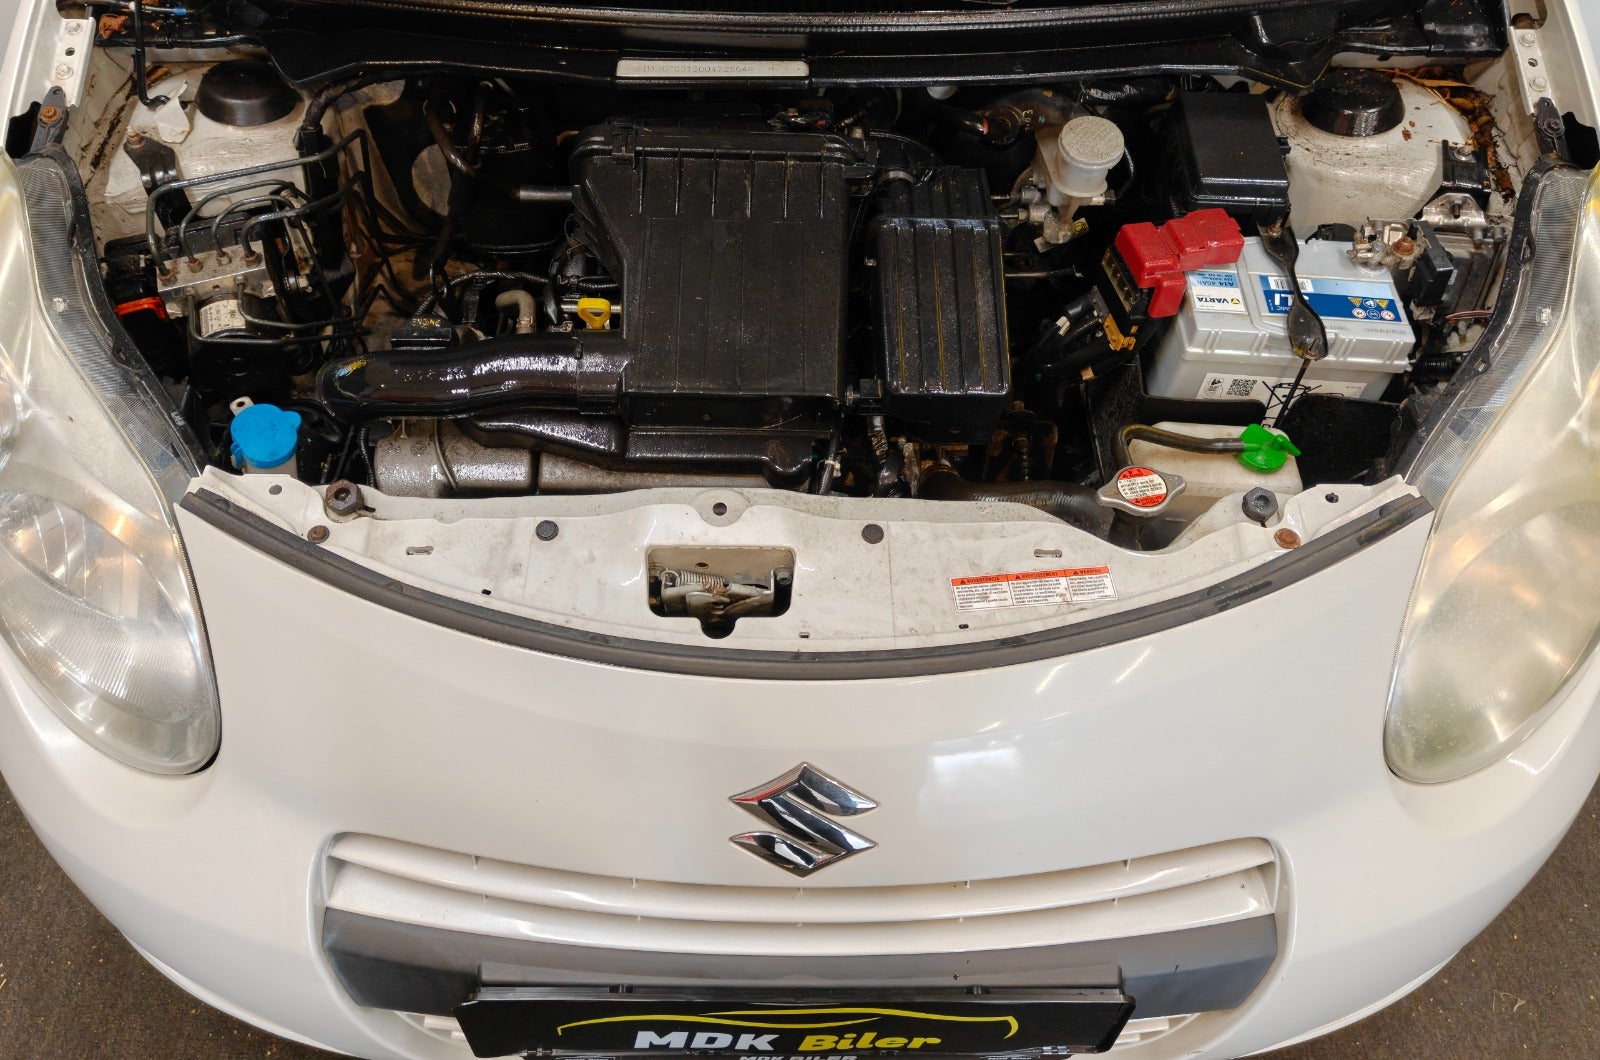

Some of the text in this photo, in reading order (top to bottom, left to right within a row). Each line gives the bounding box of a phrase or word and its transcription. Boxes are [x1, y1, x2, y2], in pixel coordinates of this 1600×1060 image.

[1196, 296, 1229, 304] VARTA
[634, 1031, 942, 1051] MDK Biler
